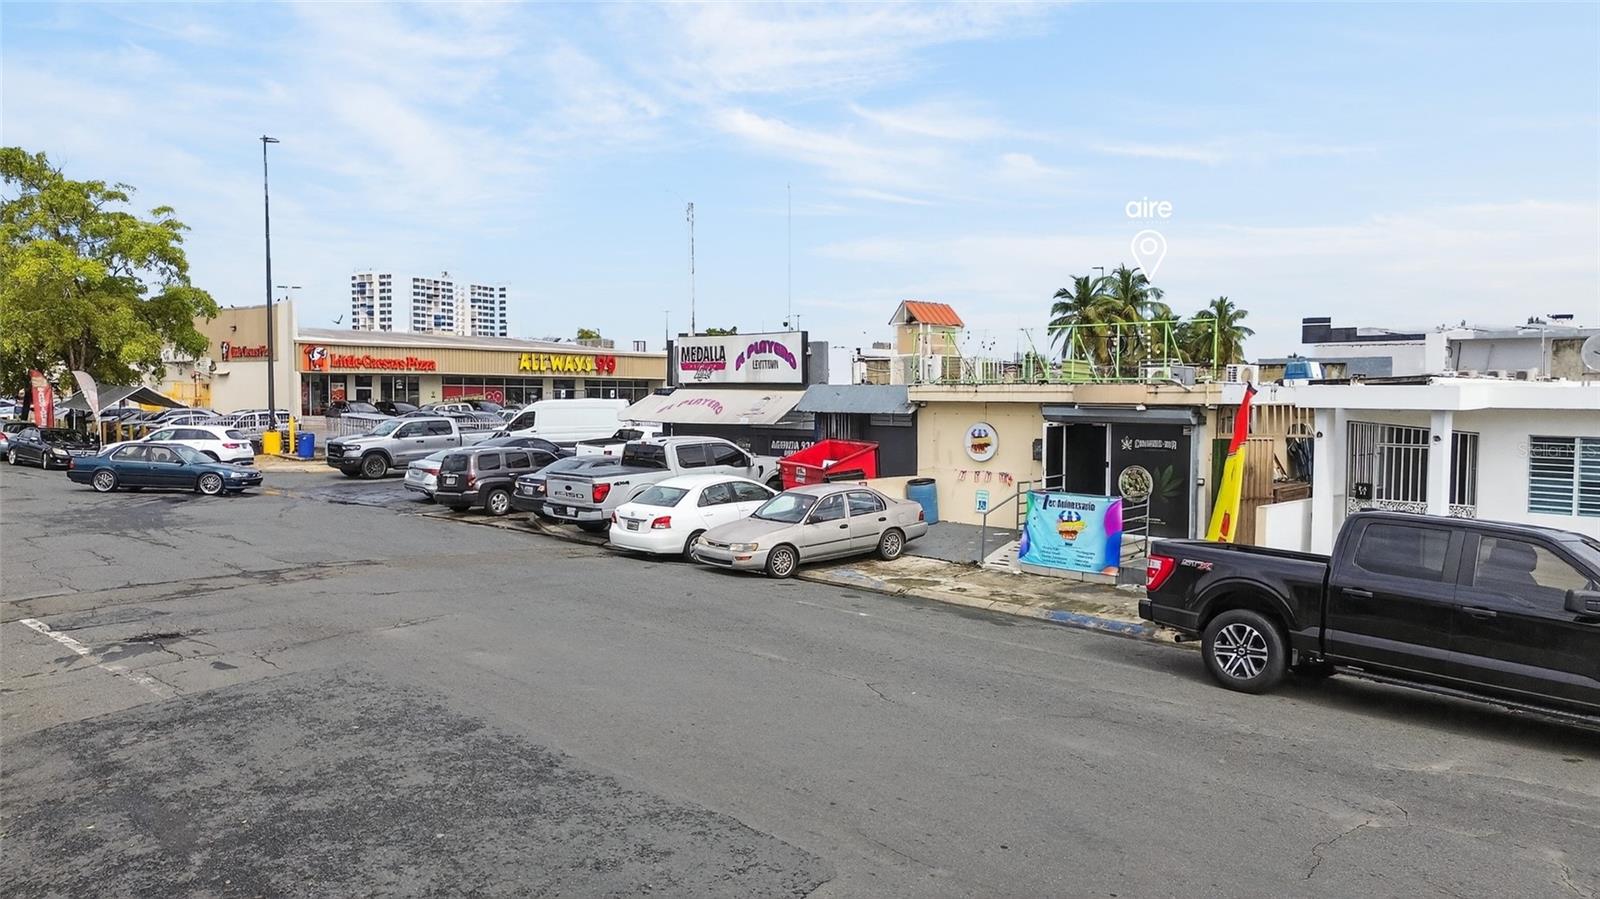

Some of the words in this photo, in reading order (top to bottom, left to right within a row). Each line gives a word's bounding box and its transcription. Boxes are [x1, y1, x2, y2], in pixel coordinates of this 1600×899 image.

[681, 345, 726, 362] MEDALLA
[330, 354, 361, 370] Little
[361, 355, 405, 371] Caesars
[405, 356, 437, 371] Pizza
[519, 352, 547, 371] ALL
[549, 354, 594, 373] WAYS
[595, 354, 616, 374] 99
[554, 491, 585, 499] F-150
